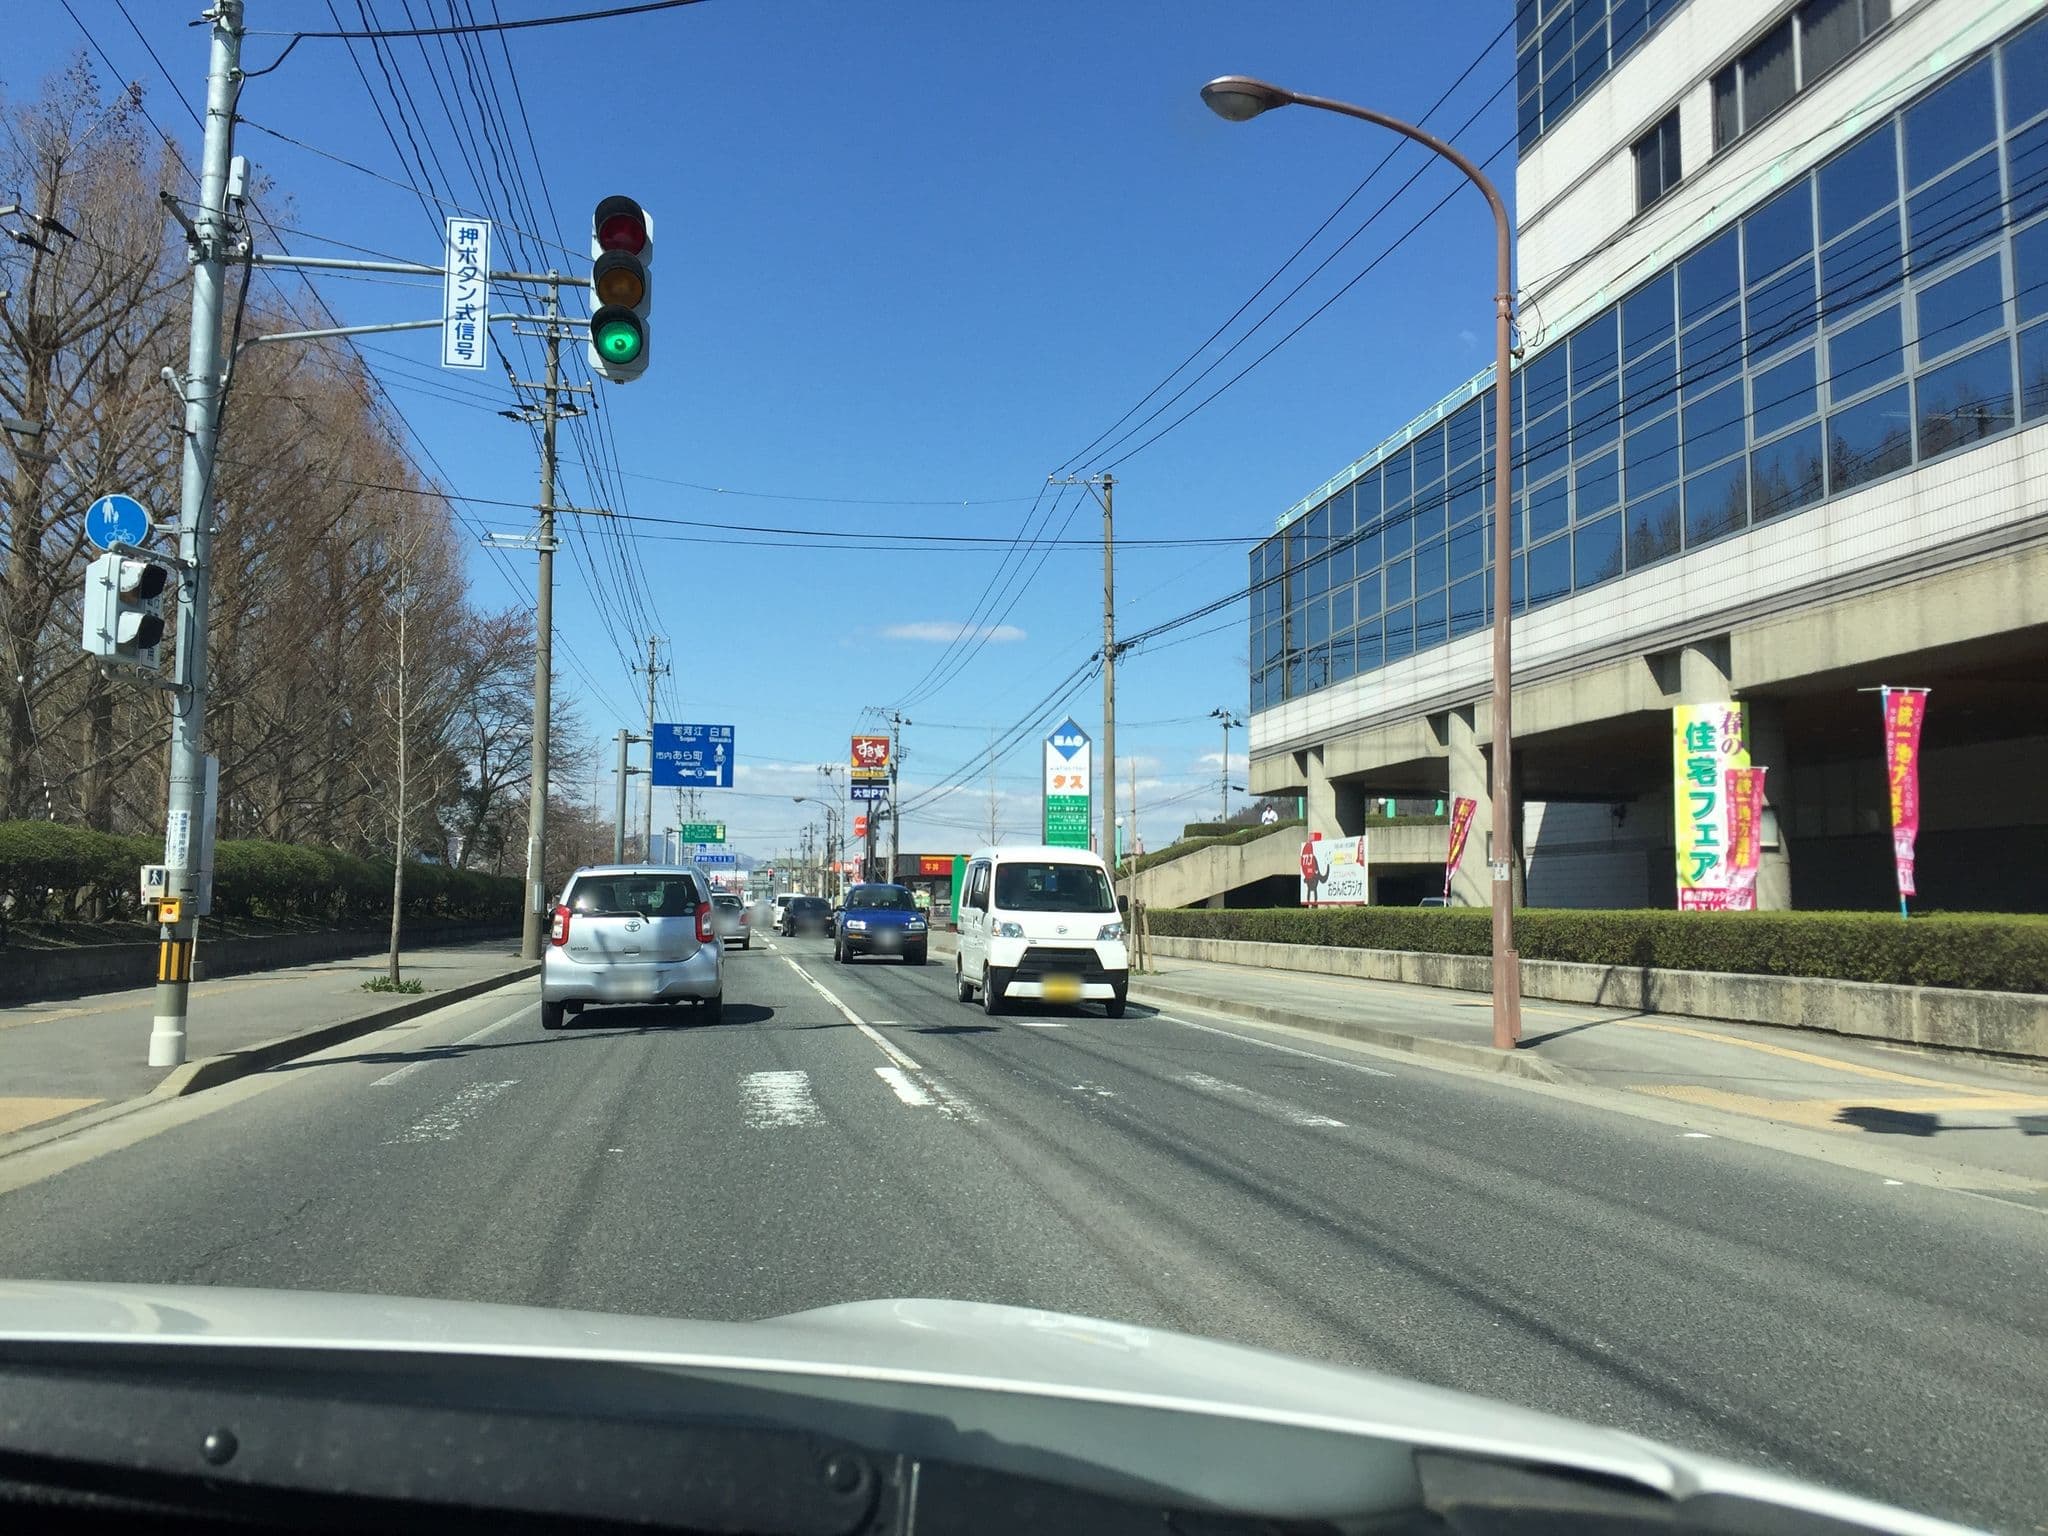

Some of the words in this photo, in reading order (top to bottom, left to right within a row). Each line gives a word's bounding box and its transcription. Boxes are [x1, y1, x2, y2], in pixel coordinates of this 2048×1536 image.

[454, 227, 479, 360] 押ボタン式信号
[856, 739, 886, 758] すき家
[1719, 710, 1743, 756] 春の
[1053, 774, 1084, 790] タス
[1685, 721, 1720, 882] 住宅フェア
[1328, 880, 1363, 897] おらんだラジオ
